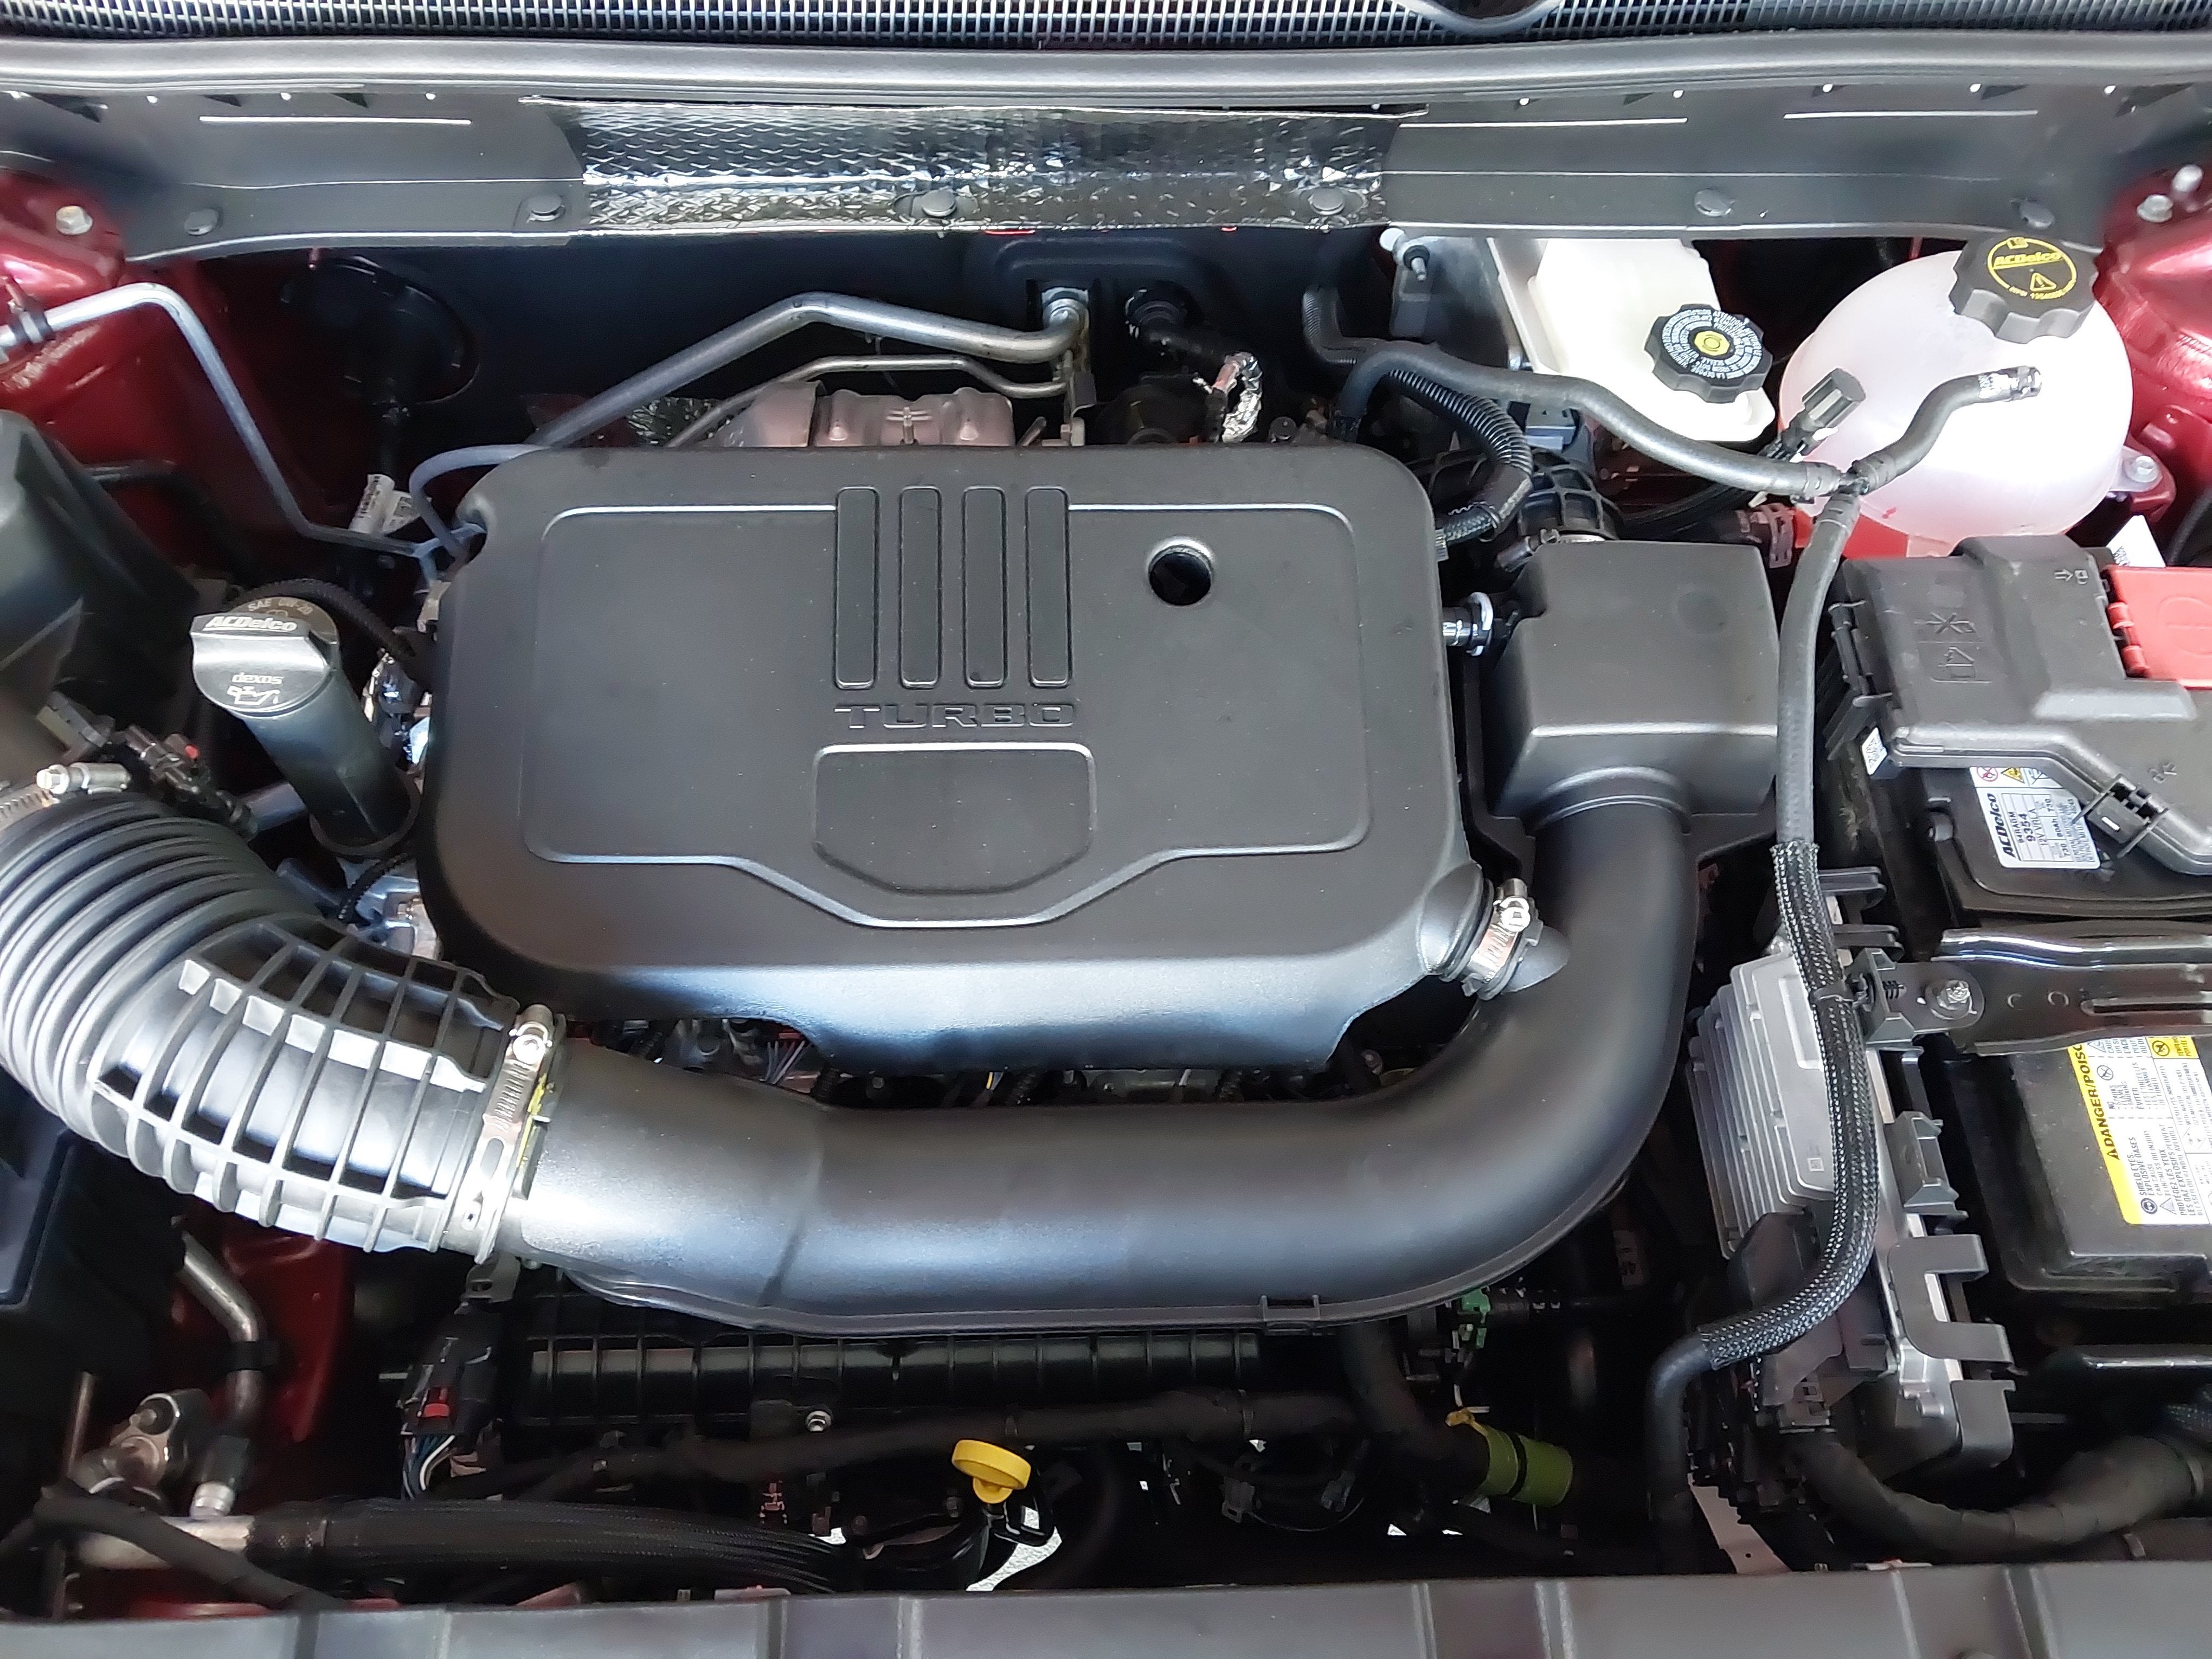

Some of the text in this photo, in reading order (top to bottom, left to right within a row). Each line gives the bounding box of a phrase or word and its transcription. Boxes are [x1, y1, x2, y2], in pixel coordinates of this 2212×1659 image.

[248, 599, 272, 612] SAE
[205, 616, 298, 632] ACDelco
[232, 672, 285, 685] dexos
[834, 704, 1075, 729] TURBO
[1986, 793, 2015, 858] ACDelco
[2017, 813, 2036, 842] 9354
[2036, 833, 2048, 845] 12V
[2136, 1160, 2155, 1195] EXPLOSIVE
[2164, 1168, 2175, 1180] LES
[2133, 1173, 2147, 1195] SHIELD
[2185, 1204, 2196, 1216] LES
